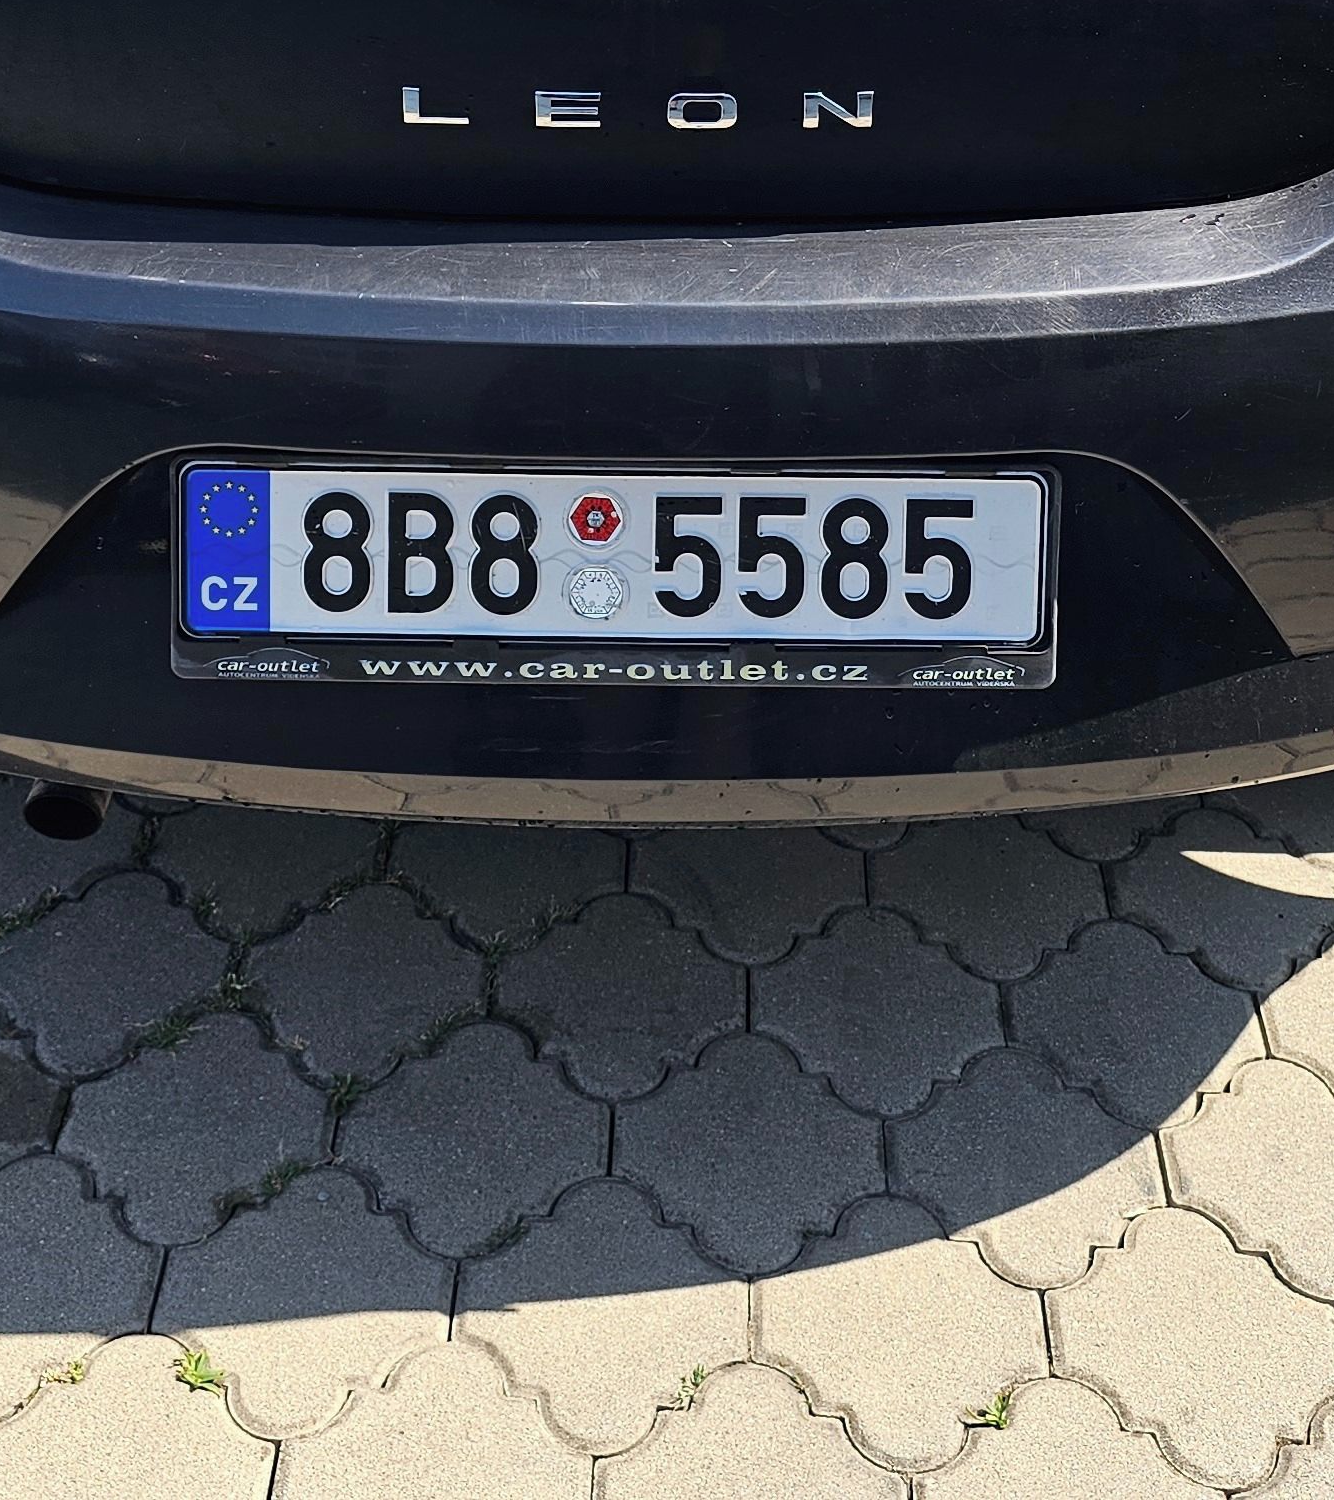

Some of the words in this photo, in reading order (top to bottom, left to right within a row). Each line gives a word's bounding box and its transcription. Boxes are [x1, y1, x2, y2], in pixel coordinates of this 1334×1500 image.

[402, 86, 875, 129] LEON
[300, 490, 541, 619] 8B8
[653, 495, 976, 621] 5585
[201, 575, 258, 611] CZ
[217, 660, 320, 673] car-outlet
[359, 659, 868, 681] www.car-outlet.cz
[912, 667, 1016, 681] car-outlet
